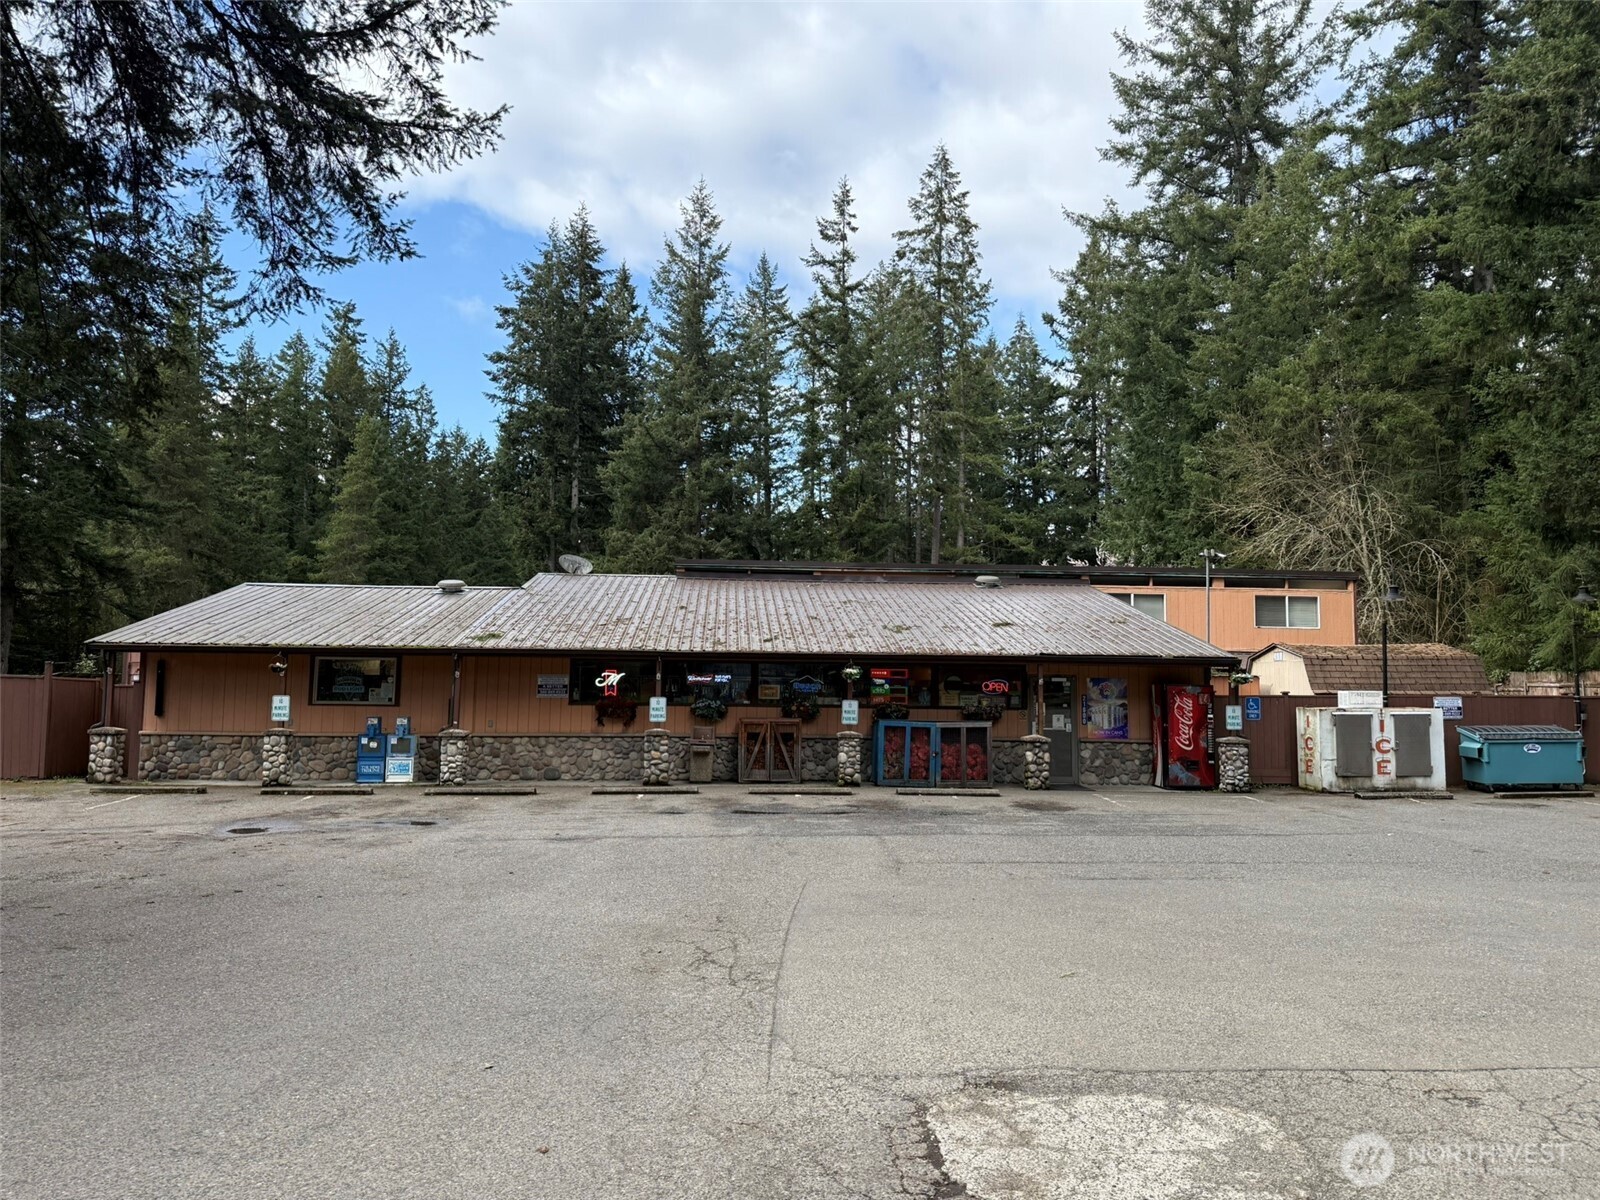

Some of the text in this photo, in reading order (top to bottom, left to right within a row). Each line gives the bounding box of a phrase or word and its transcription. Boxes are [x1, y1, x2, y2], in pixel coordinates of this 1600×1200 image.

[982, 681, 1008, 692] OPEN
[1304, 714, 1314, 774] ICE
[1375, 719, 1391, 776] ICE
